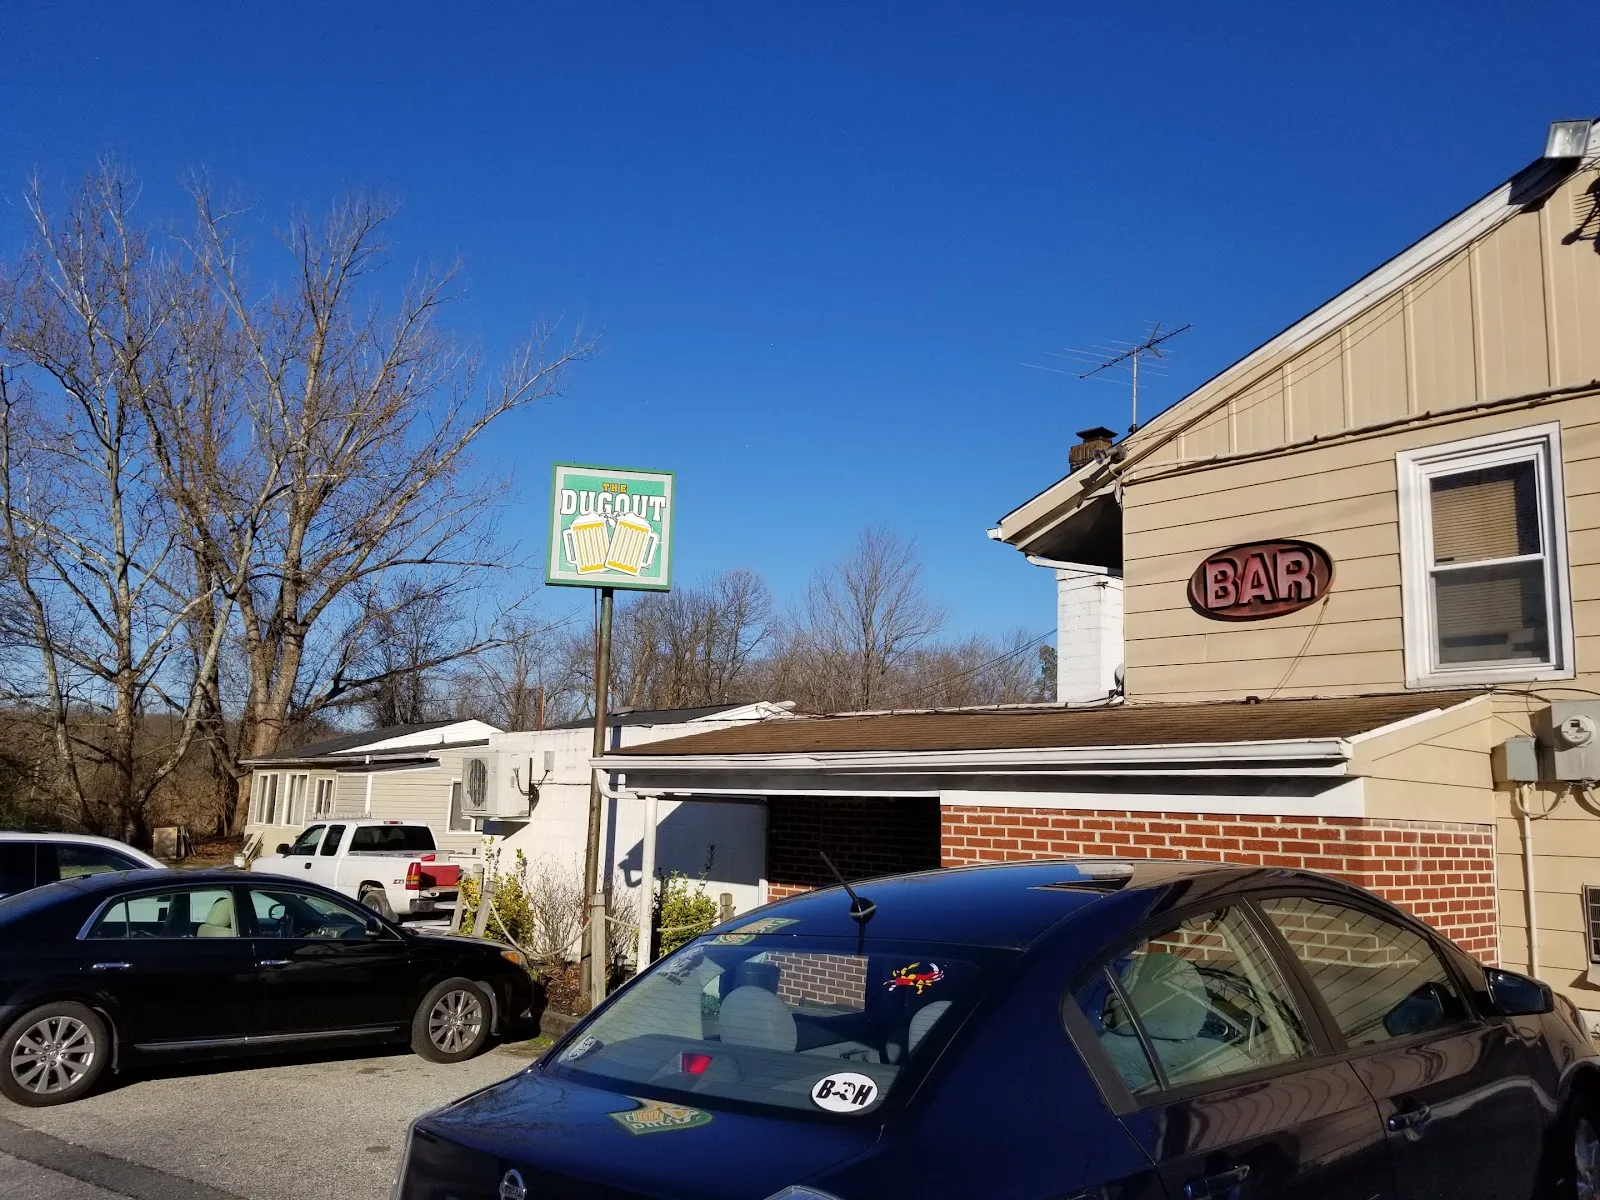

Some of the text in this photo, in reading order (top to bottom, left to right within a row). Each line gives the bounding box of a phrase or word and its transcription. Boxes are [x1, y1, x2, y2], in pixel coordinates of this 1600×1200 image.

[602, 482, 628, 493] THE
[560, 489, 666, 522] DUGOUT
[1204, 548, 1317, 610] BAR
